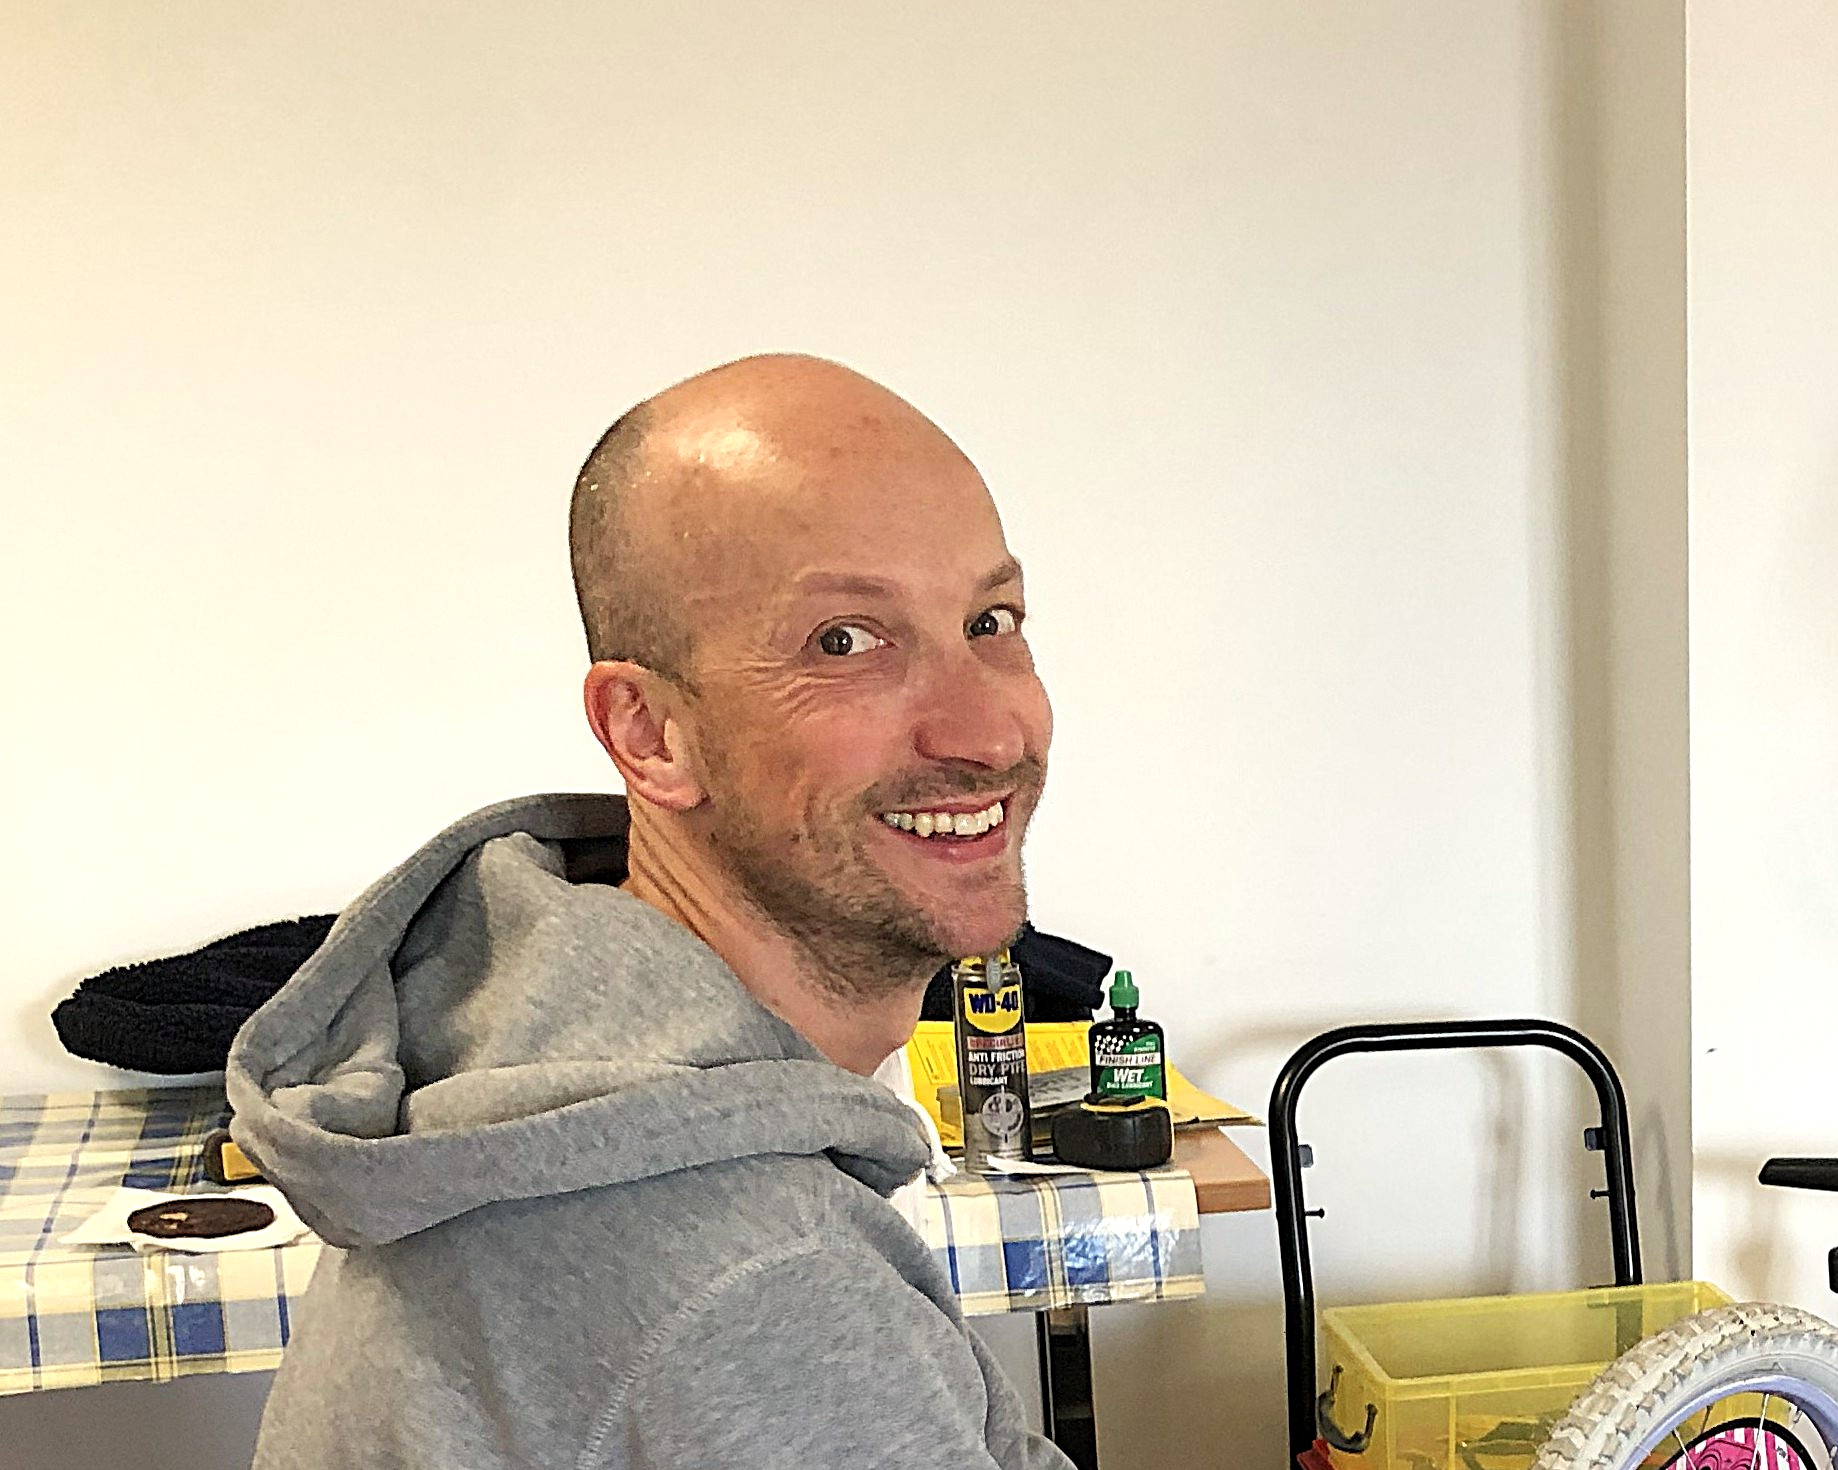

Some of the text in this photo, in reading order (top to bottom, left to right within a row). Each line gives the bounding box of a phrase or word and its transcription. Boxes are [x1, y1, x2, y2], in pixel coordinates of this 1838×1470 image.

[969, 990, 1019, 1014] WD-40
[968, 1051, 988, 1062] ANTI
[1099, 1054, 1156, 1065] FINISH LINE
[969, 1062, 996, 1076] DRY
[1113, 1068, 1145, 1085] WET
